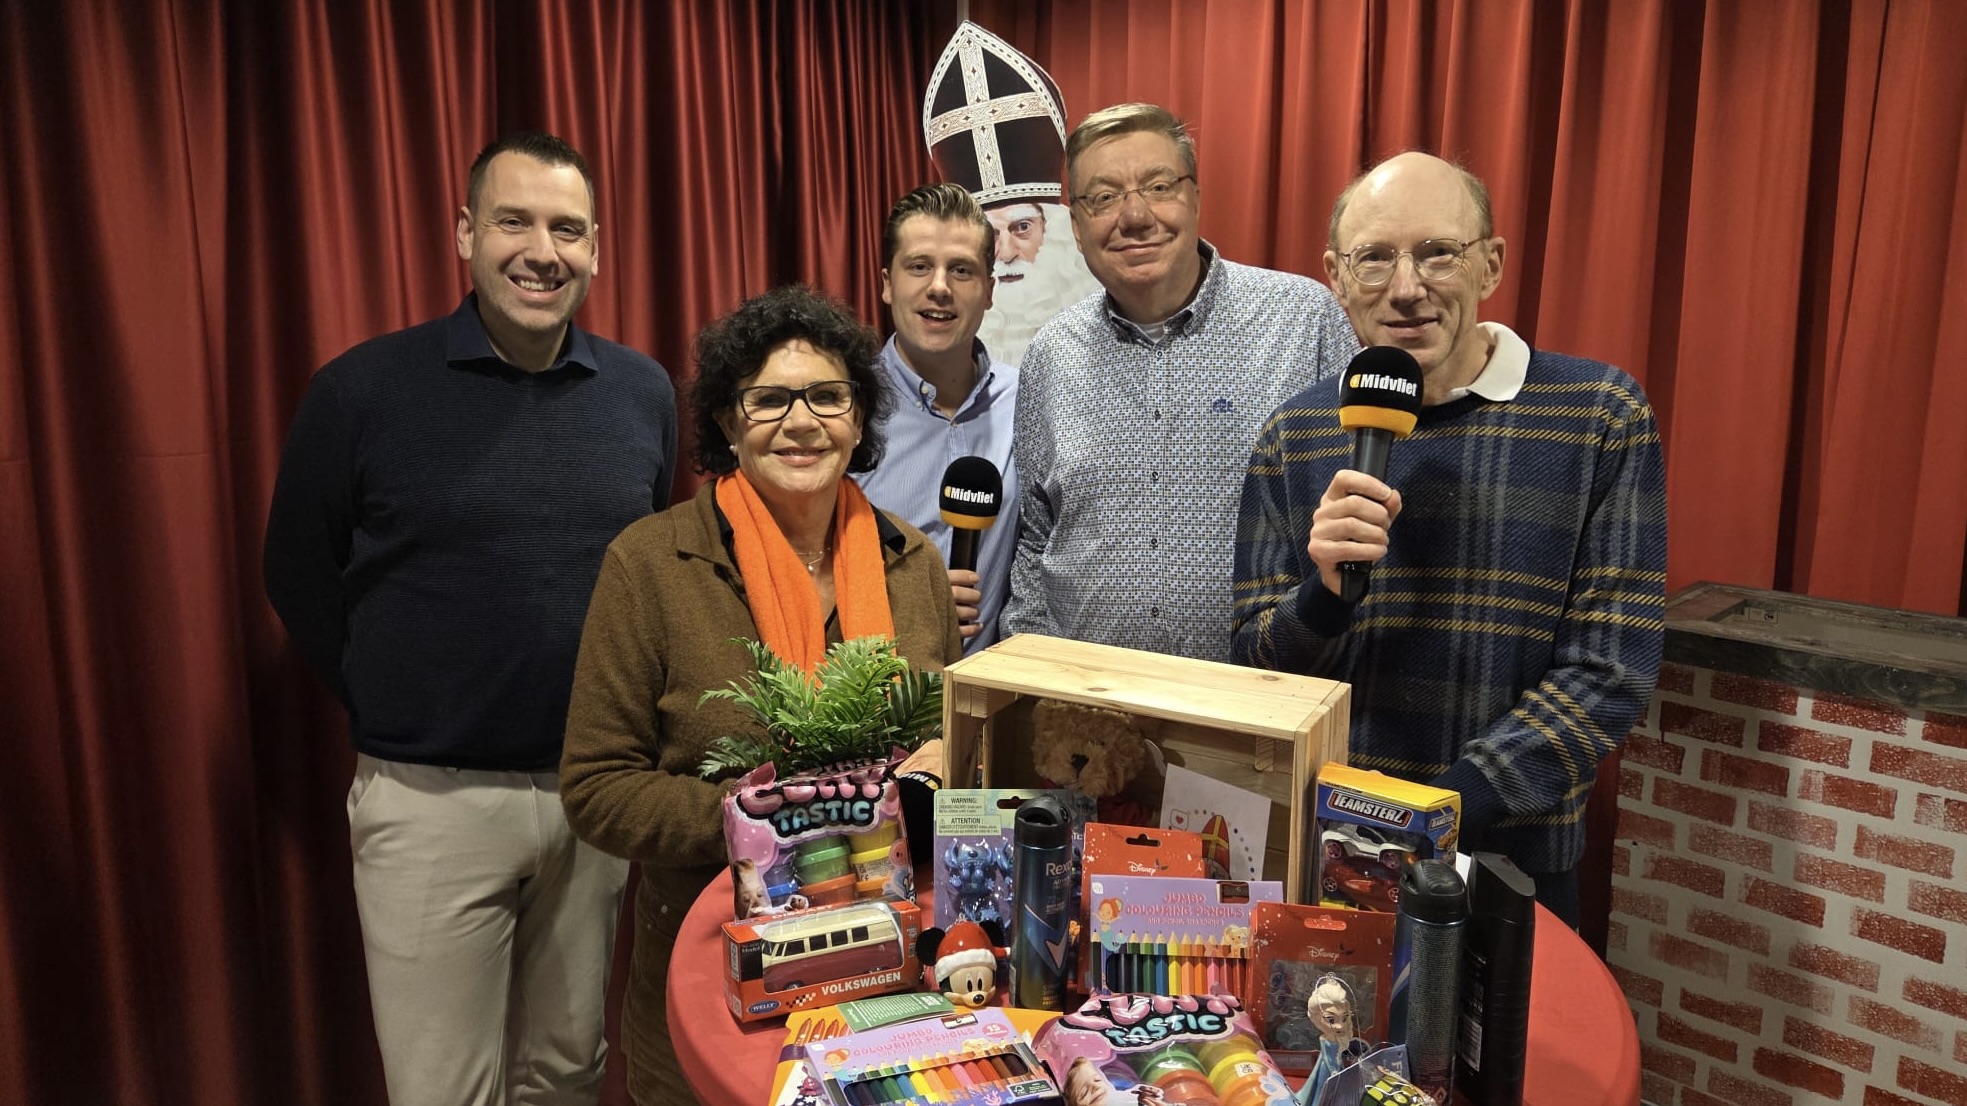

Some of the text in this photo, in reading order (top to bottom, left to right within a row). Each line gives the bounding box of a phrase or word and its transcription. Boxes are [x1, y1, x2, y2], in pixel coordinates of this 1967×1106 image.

[1360, 373, 1418, 397] Midvliet
[950, 486, 994, 504] Midvliet
[773, 801, 871, 832] TASTIC
[1333, 792, 1406, 824] TEAMSTERZ
[1127, 860, 1157, 876] Disney
[1164, 891, 1206, 904] JUMBO
[1126, 904, 1246, 919] COLOURING PENCILS
[1307, 945, 1341, 961] Disney
[821, 971, 901, 996] VOLKSWAGEN
[752, 1002, 776, 1012] WELLY
[888, 1027, 934, 1041] JUMBO
[1106, 1014, 1222, 1045] TASTIC
[853, 1037, 923, 1056] COLOURING
[925, 1027, 976, 1045] PENCILS
